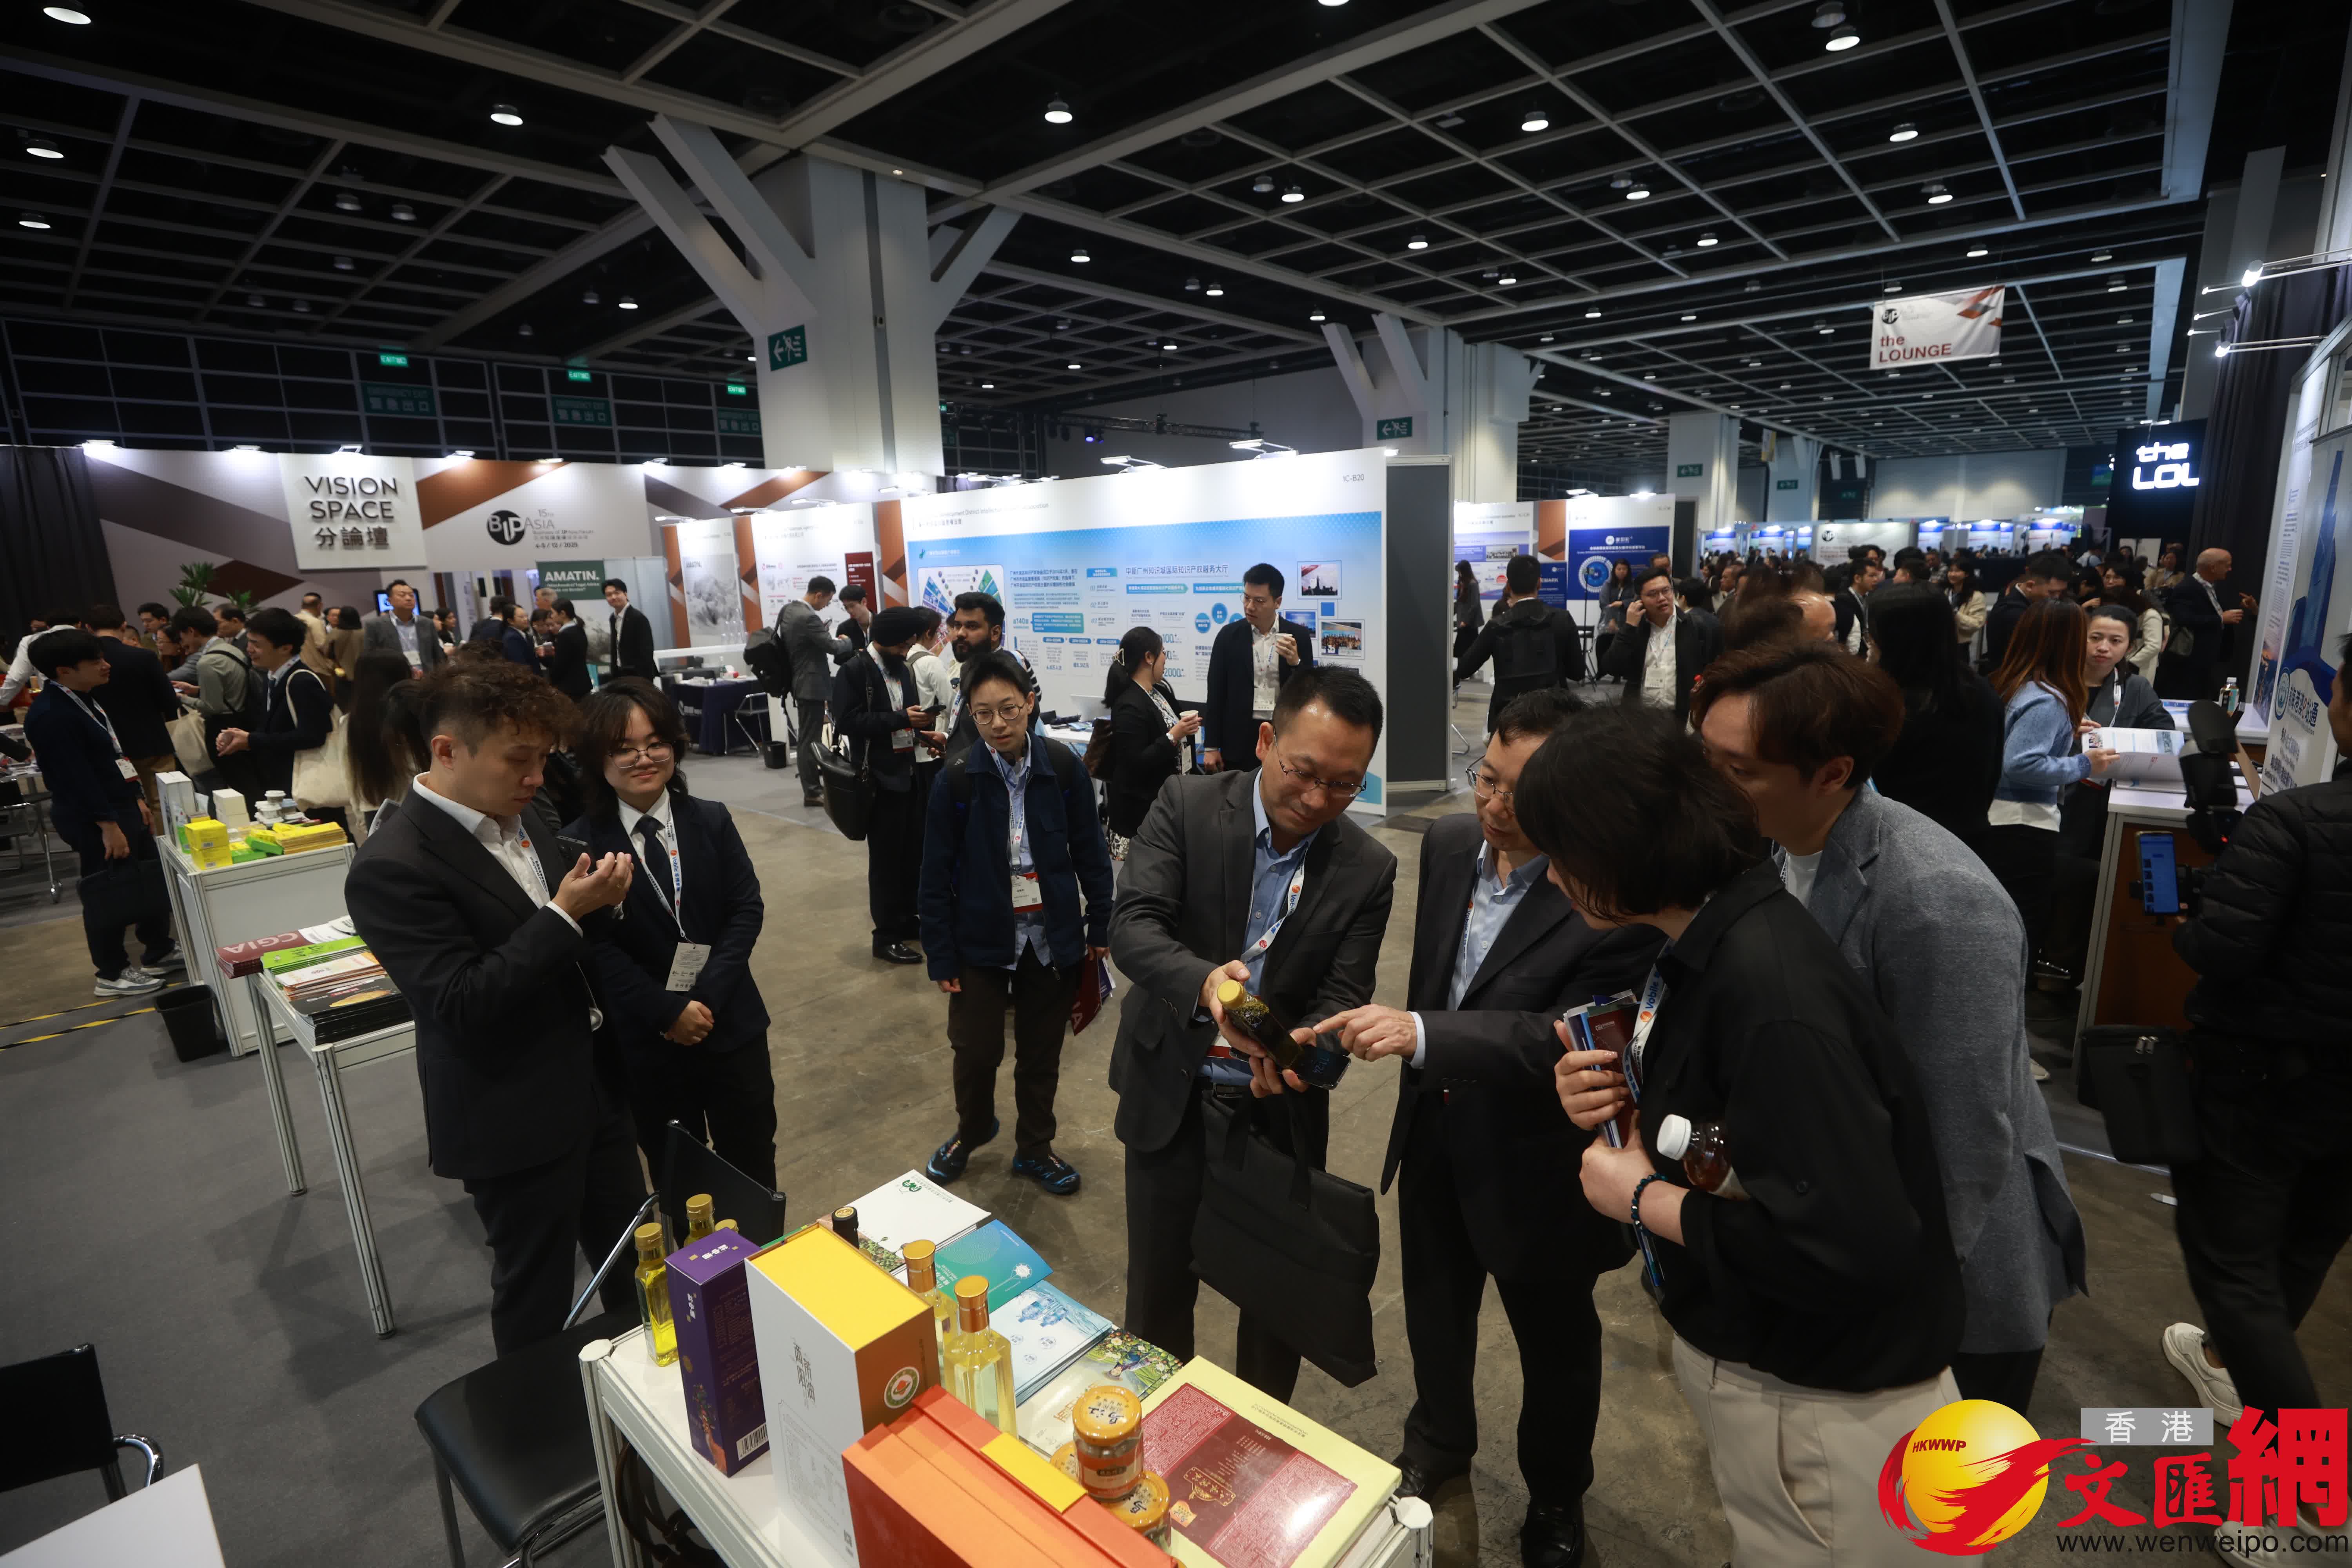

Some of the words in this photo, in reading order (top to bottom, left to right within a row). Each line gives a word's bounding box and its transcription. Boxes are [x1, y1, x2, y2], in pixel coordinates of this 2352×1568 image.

[1880, 336, 1905, 347] the
[1879, 343, 1952, 363] LOUNGE
[2136, 441, 2189, 463] the
[305, 476, 398, 495] VISION
[1342, 474, 1365, 482] 1C-B20
[311, 501, 393, 519] SPACE
[316, 526, 389, 547] 分論壇
[544, 570, 600, 581] AMATIN.
[223, 932, 298, 954] CGIA
[1645, 981, 1659, 1009] Vobile
